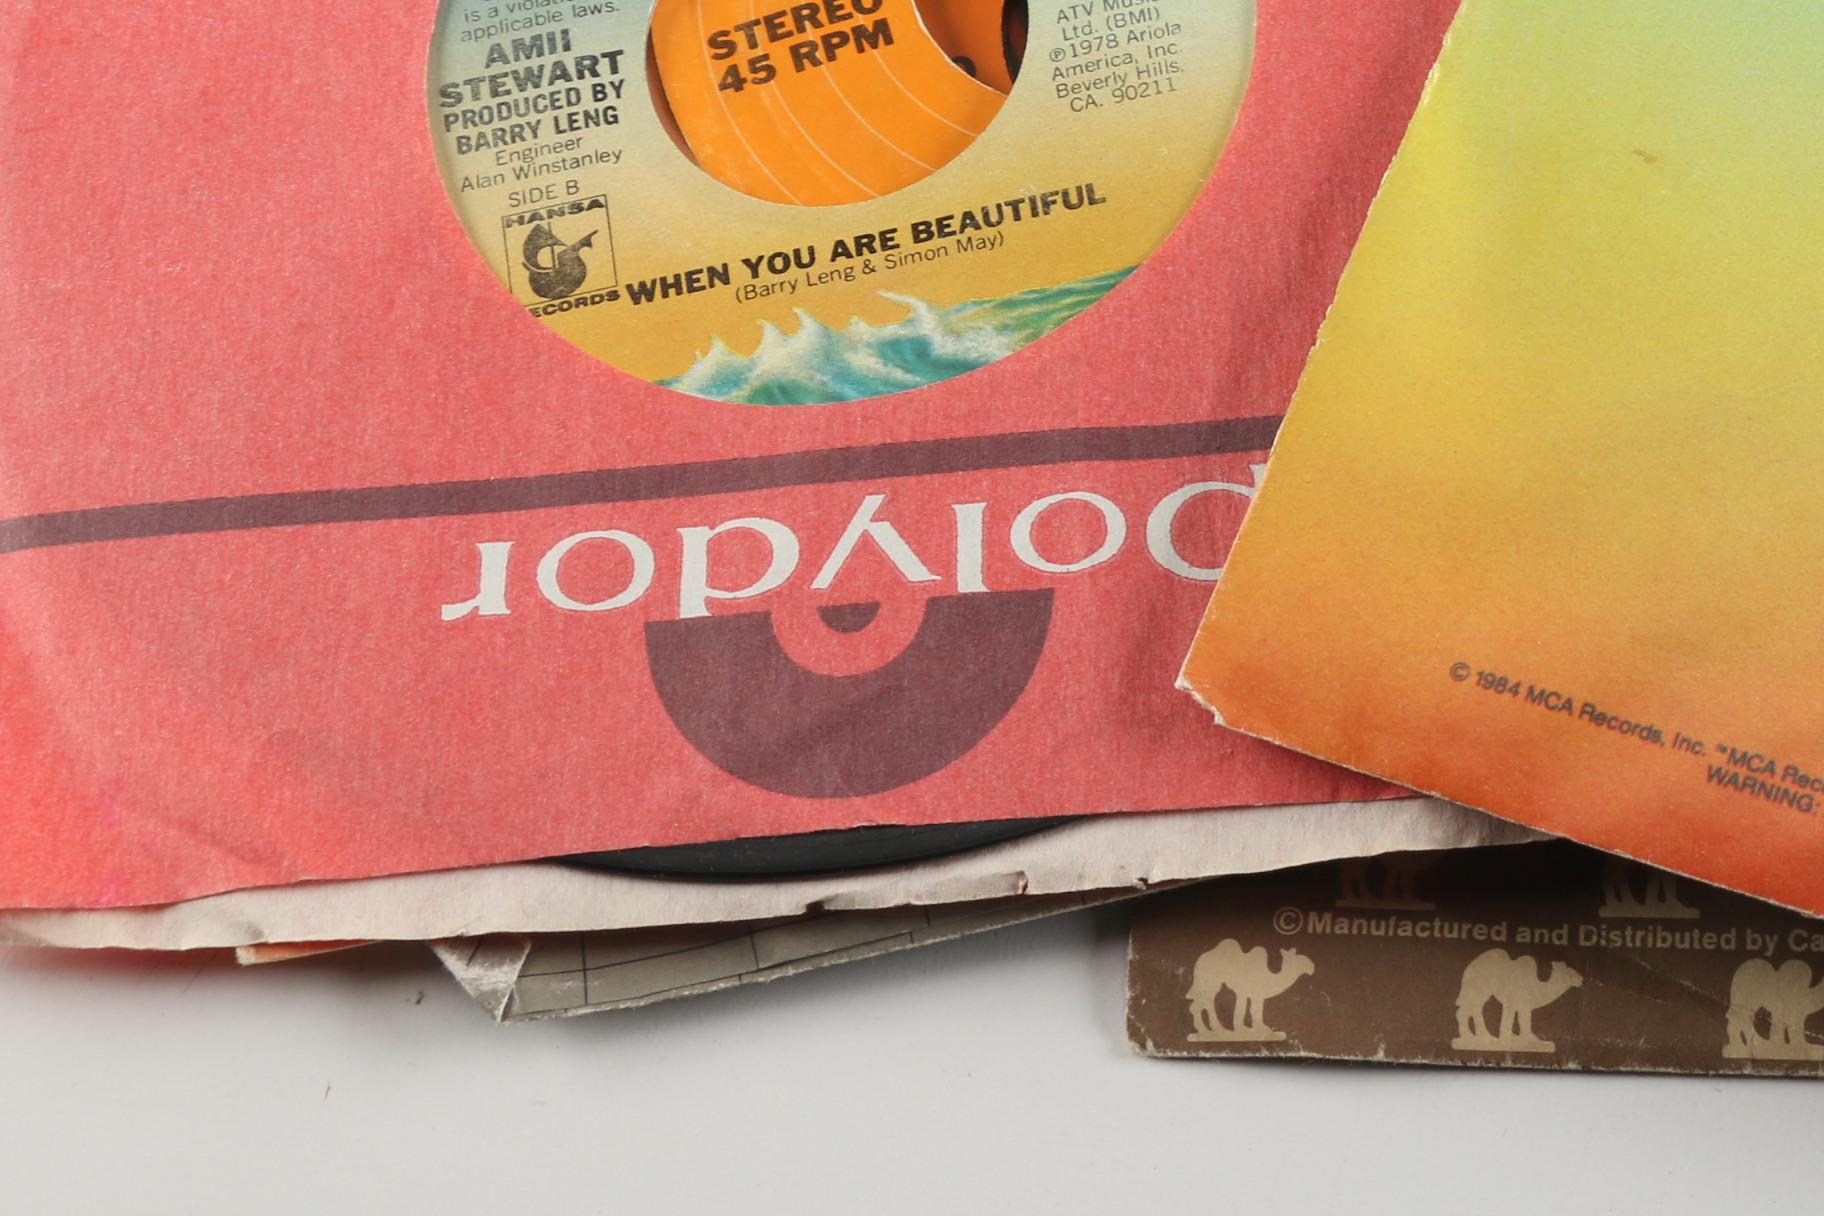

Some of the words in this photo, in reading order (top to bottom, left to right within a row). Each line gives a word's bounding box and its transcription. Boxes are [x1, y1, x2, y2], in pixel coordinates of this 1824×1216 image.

[460, 8, 563, 44] applicable
[572, 1, 621, 22] laws.
[1056, 2, 1094, 25] ATV
[1062, 23, 1099, 42] Ltd.
[1106, 6, 1160, 33] (BMI)
[1127, 21, 1182, 44] Ariola
[484, 28, 572, 69] AMII
[717, 54, 778, 94] 45
[789, 17, 895, 74] RPM
[1052, 51, 1139, 82] America,
[1147, 41, 1184, 60] Inc.
[439, 50, 625, 109] STEWART
[1055, 73, 1128, 99] Beverly
[1113, 78, 1177, 105] 90211
[443, 88, 582, 132] PRODUCED
[591, 78, 626, 103] BY
[456, 120, 542, 156] BARRY
[554, 106, 619, 134] LENG
[495, 136, 583, 167] Engineer
[460, 169, 505, 193] Alan
[512, 149, 624, 181] Winstanley
[508, 184, 561, 208] SIDE
[566, 179, 580, 196] B
[507, 200, 606, 229] HANSA
[626, 262, 731, 306] WHEN
[742, 245, 817, 280] YOU
[829, 227, 901, 263] ARE
[911, 182, 1107, 245] BEAUTIFUL
[735, 277, 799, 304] (Barry
[806, 262, 856, 288] Leng
[862, 257, 878, 275] &
[884, 245, 949, 270] Simon
[956, 229, 1005, 254] May)
[529, 288, 621, 319] ECORDS
[1475, 670, 1521, 699] 1984
[1525, 685, 1574, 717] MCA
[1579, 702, 1666, 747] Records,
[1672, 731, 1706, 757] Inc.
[1706, 765, 1821, 813] WARNING:
[1515, 926, 1569, 947] and
[1579, 924, 1738, 951] Distributed
[1745, 928, 1779, 956] by
